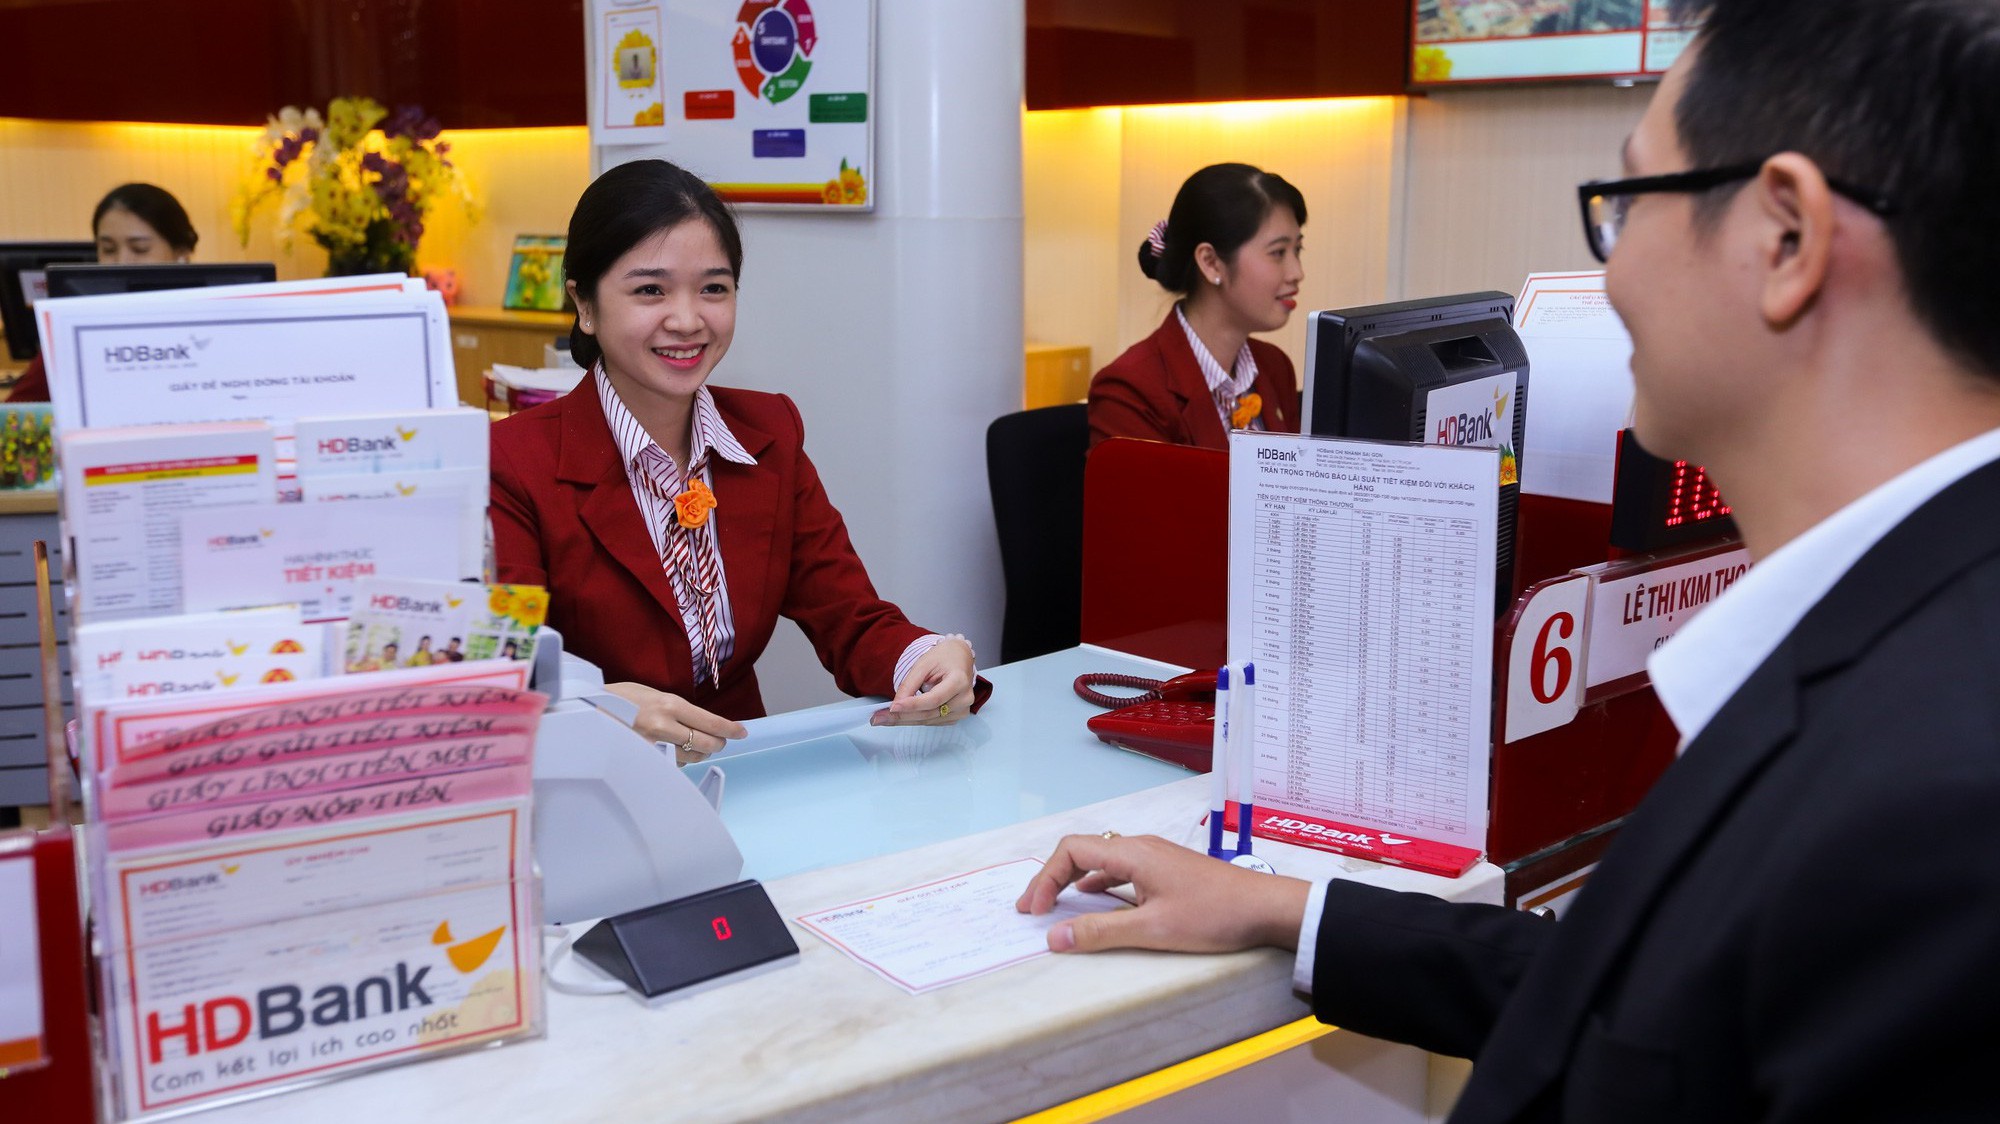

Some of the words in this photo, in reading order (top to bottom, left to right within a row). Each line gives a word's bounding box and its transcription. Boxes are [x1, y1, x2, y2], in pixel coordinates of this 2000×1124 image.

[757, 21, 766, 35] 5
[804, 37, 812, 51] 1
[767, 84, 776, 98] 2
[104, 343, 190, 363] HDBank
[1437, 407, 1492, 445] HDBank
[317, 434, 398, 454] HDBank
[1257, 447, 1297, 462] HDBank
[1260, 465, 1279, 474] TRÂN
[1280, 468, 1304, 477] TRỌNG
[1305, 469, 1330, 479] THÔNG
[1331, 472, 1347, 480] BÁO
[1348, 473, 1360, 482] LÃI
[1361, 475, 1381, 484] SUẤT
[1382, 476, 1398, 485] TIẾT
[1399, 478, 1417, 487] KIỆM
[1419, 479, 1432, 488] ĐỐI
[1433, 481, 1447, 489] VỚI
[1448, 482, 1475, 491] KHÁCH
[1353, 483, 1374, 492] HÀNG
[283, 563, 323, 583] TIẾT
[370, 594, 443, 613] HDBank
[1623, 583, 1645, 625] LÊ
[1648, 581, 1676, 622] THỊ
[1678, 572, 1711, 610] KIM
[1529, 611, 1574, 704] 6
[325, 720, 404, 748] TIẾT
[148, 774, 235, 812] GIẤY
[425, 742, 496, 769] MẶT
[206, 803, 290, 838] GIẤY
[293, 794, 364, 823] NỘP
[369, 774, 453, 811] TIỀN
[1259, 823, 1278, 831] Cam
[1264, 815, 1375, 845] HDBank
[139, 871, 220, 895] HDBank
[711, 915, 733, 941] 0
[146, 962, 434, 1065] HDBank
[150, 1069, 205, 1093] Cam
[216, 1055, 257, 1077] kết
[268, 1049, 300, 1067] lợi
[311, 1037, 343, 1056] ích
[355, 1025, 396, 1048] cao
[407, 1011, 459, 1039] nhất
